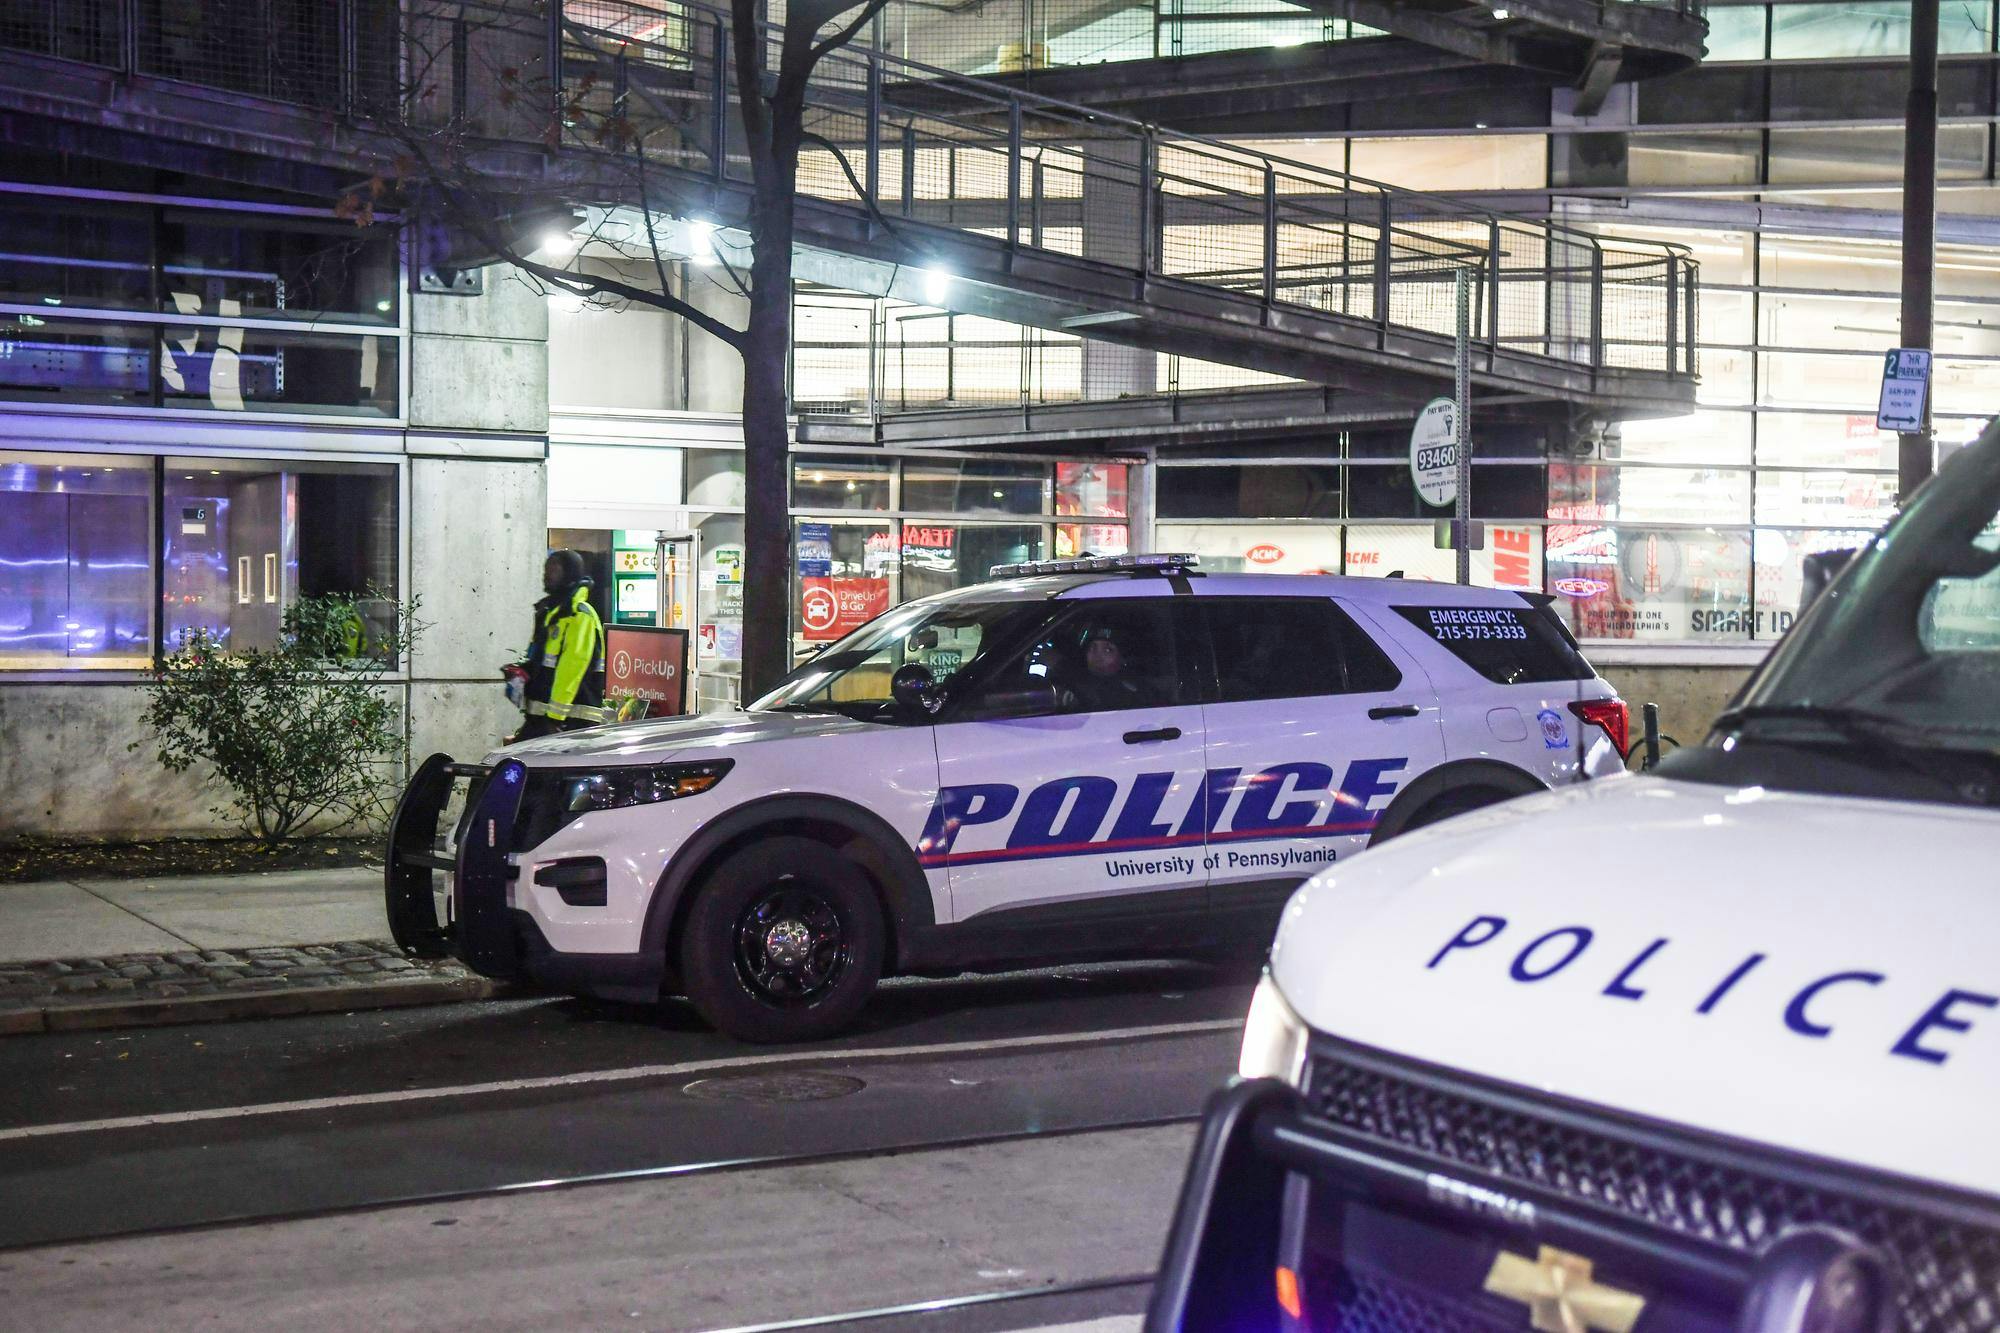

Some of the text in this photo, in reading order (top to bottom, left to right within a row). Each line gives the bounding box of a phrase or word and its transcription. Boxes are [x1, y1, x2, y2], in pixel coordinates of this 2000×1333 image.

[1887, 354, 1897, 375] 2
[1427, 403, 1452, 415] PAY WITH
[1419, 445, 1455, 470] 93460
[1251, 549, 1279, 559] ACME
[840, 591, 876, 604] DriveUp
[841, 601, 848, 610] &
[1428, 610, 1517, 624] EMERGENCY:
[1587, 611, 1662, 620] PROUD TO BE ONE
[1691, 610, 1763, 633] SMART
[1434, 625, 1527, 640] 215-573-3333
[1600, 622, 1669, 631] PHILADELPHIA'S
[929, 655, 960, 666] KING
[633, 658, 675, 680] PickUp
[933, 667, 956, 677] STATE
[918, 757, 1408, 854] POLICE
[1106, 846, 1337, 879] University of Pennsylvania
[1426, 914, 2000, 1066] POLICE
